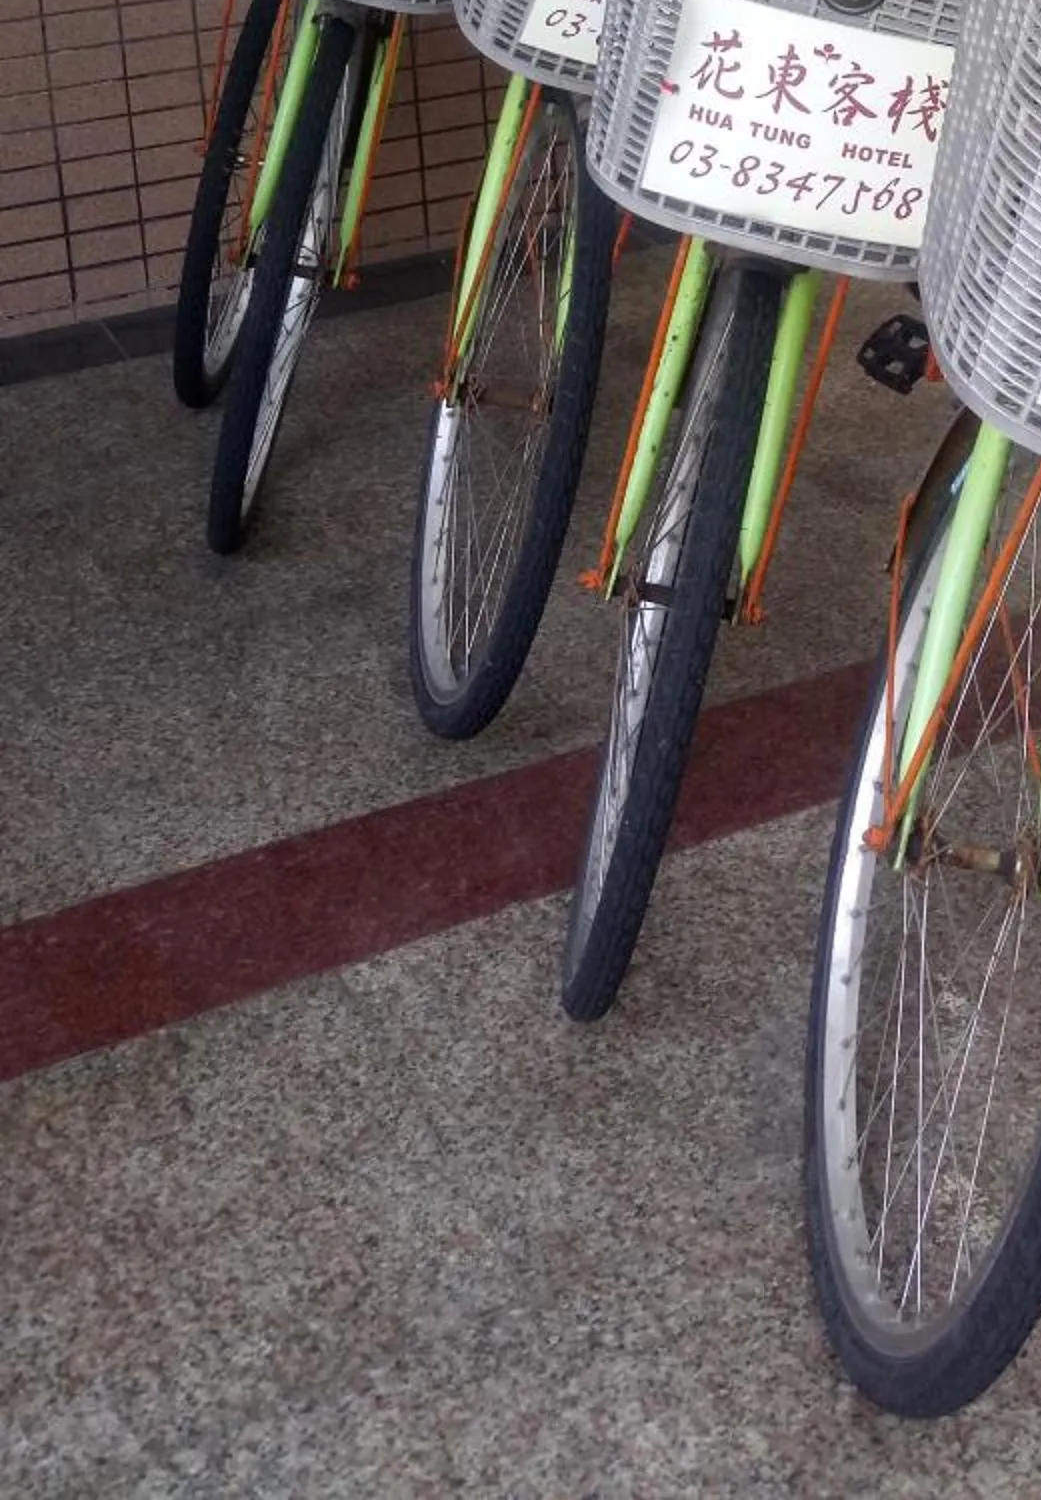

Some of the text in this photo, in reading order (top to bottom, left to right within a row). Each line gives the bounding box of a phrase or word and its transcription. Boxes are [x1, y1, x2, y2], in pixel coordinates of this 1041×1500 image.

[546, 8, 602, 46] 03-
[688, 103, 914, 170] HUA TUNG HOTEL
[669, 140, 922, 220] 03-8347568
